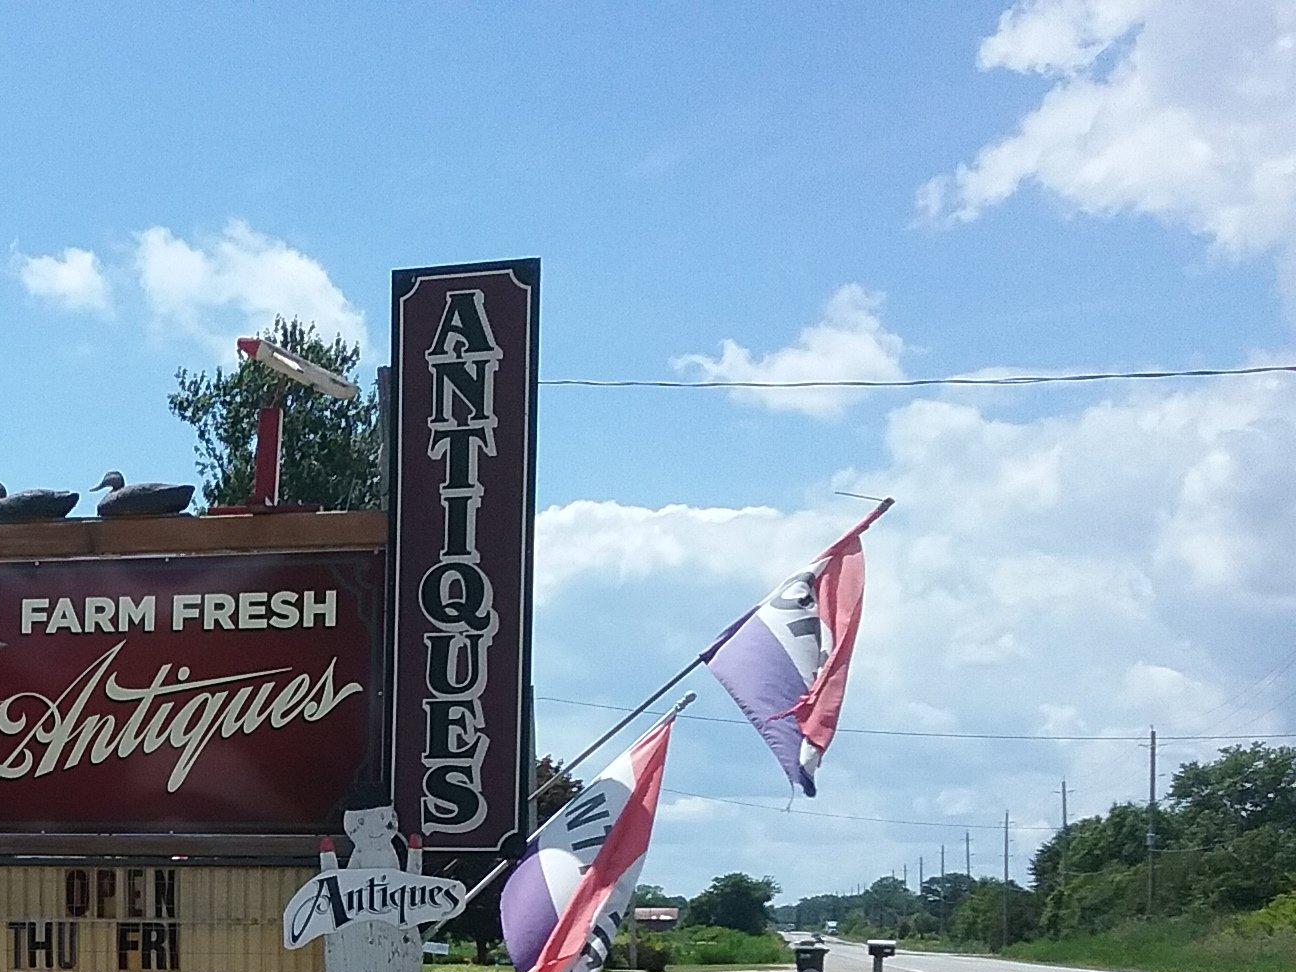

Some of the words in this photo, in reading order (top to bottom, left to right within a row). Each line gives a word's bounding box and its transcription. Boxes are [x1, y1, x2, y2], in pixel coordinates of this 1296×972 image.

[418, 288, 503, 835] ANTIQUES
[21, 595, 156, 634] FARM
[173, 589, 338, 631] FRESH
[65, 869, 176, 919] OPEN
[291, 874, 461, 945] Antiques
[8, 921, 78, 970] THU
[116, 922, 180, 970] FRI
